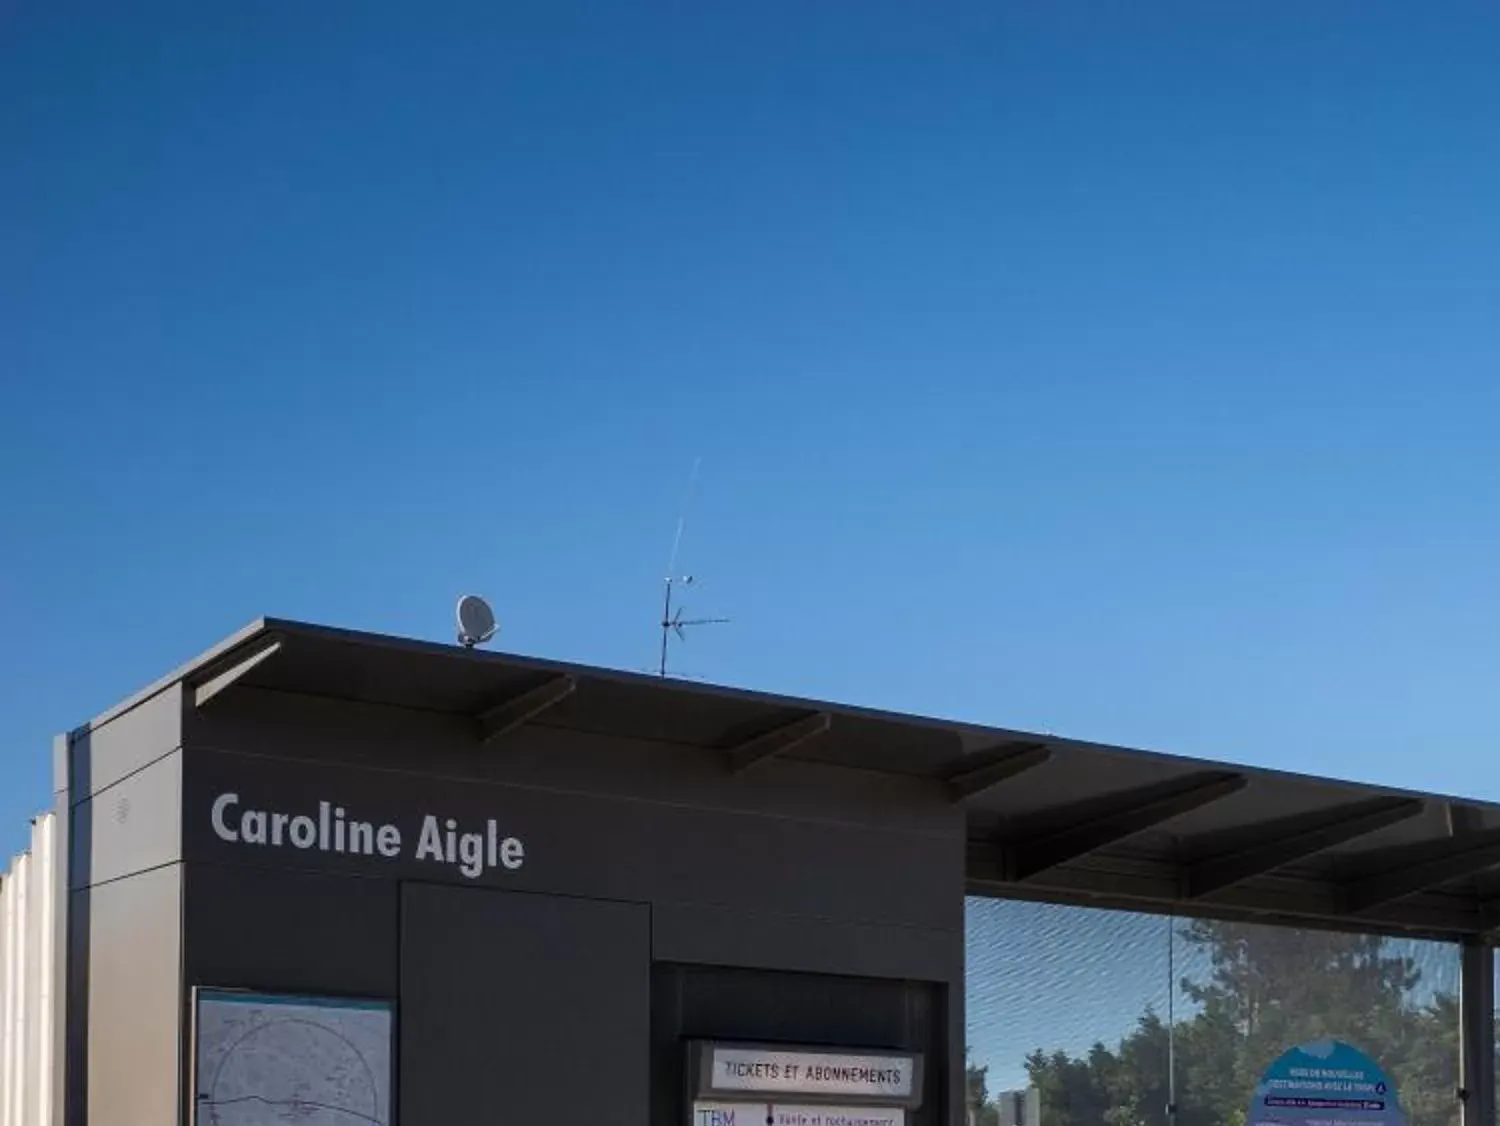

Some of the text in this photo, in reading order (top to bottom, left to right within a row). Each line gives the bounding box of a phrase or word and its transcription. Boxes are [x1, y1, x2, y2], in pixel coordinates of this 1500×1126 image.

[211, 793, 525, 879] Caroline Aigle
[724, 1060, 901, 1085] TICKETS ET ABONNEMENTS
